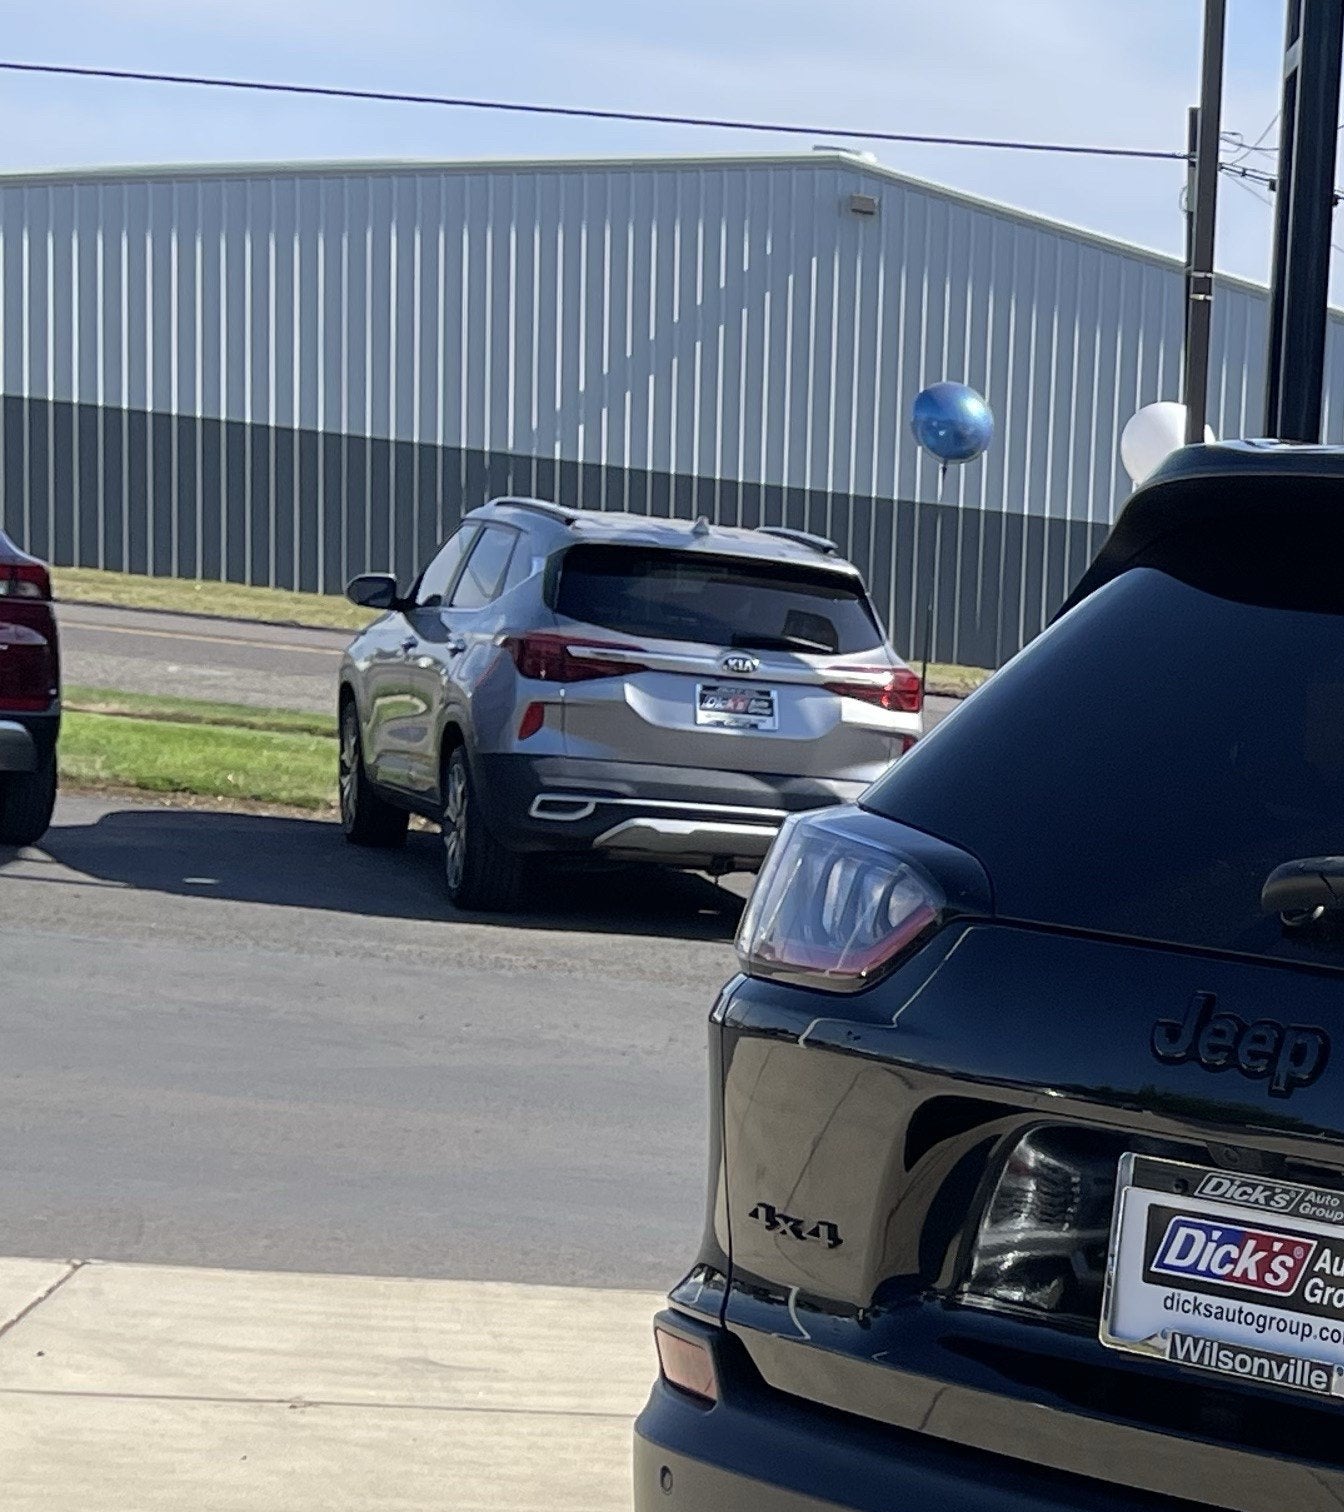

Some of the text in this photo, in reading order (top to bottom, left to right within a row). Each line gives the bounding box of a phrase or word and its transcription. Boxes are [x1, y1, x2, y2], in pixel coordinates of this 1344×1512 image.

[728, 658, 754, 671] KIA
[1151, 989, 1331, 1099] Jeep
[1200, 1176, 1290, 1210] Dick's
[1303, 1191, 1341, 1207] Auto
[1299, 1201, 1344, 1222] Group
[1163, 1226, 1294, 1287] Dick's
[1170, 1333, 1329, 1391] Wilsonville
